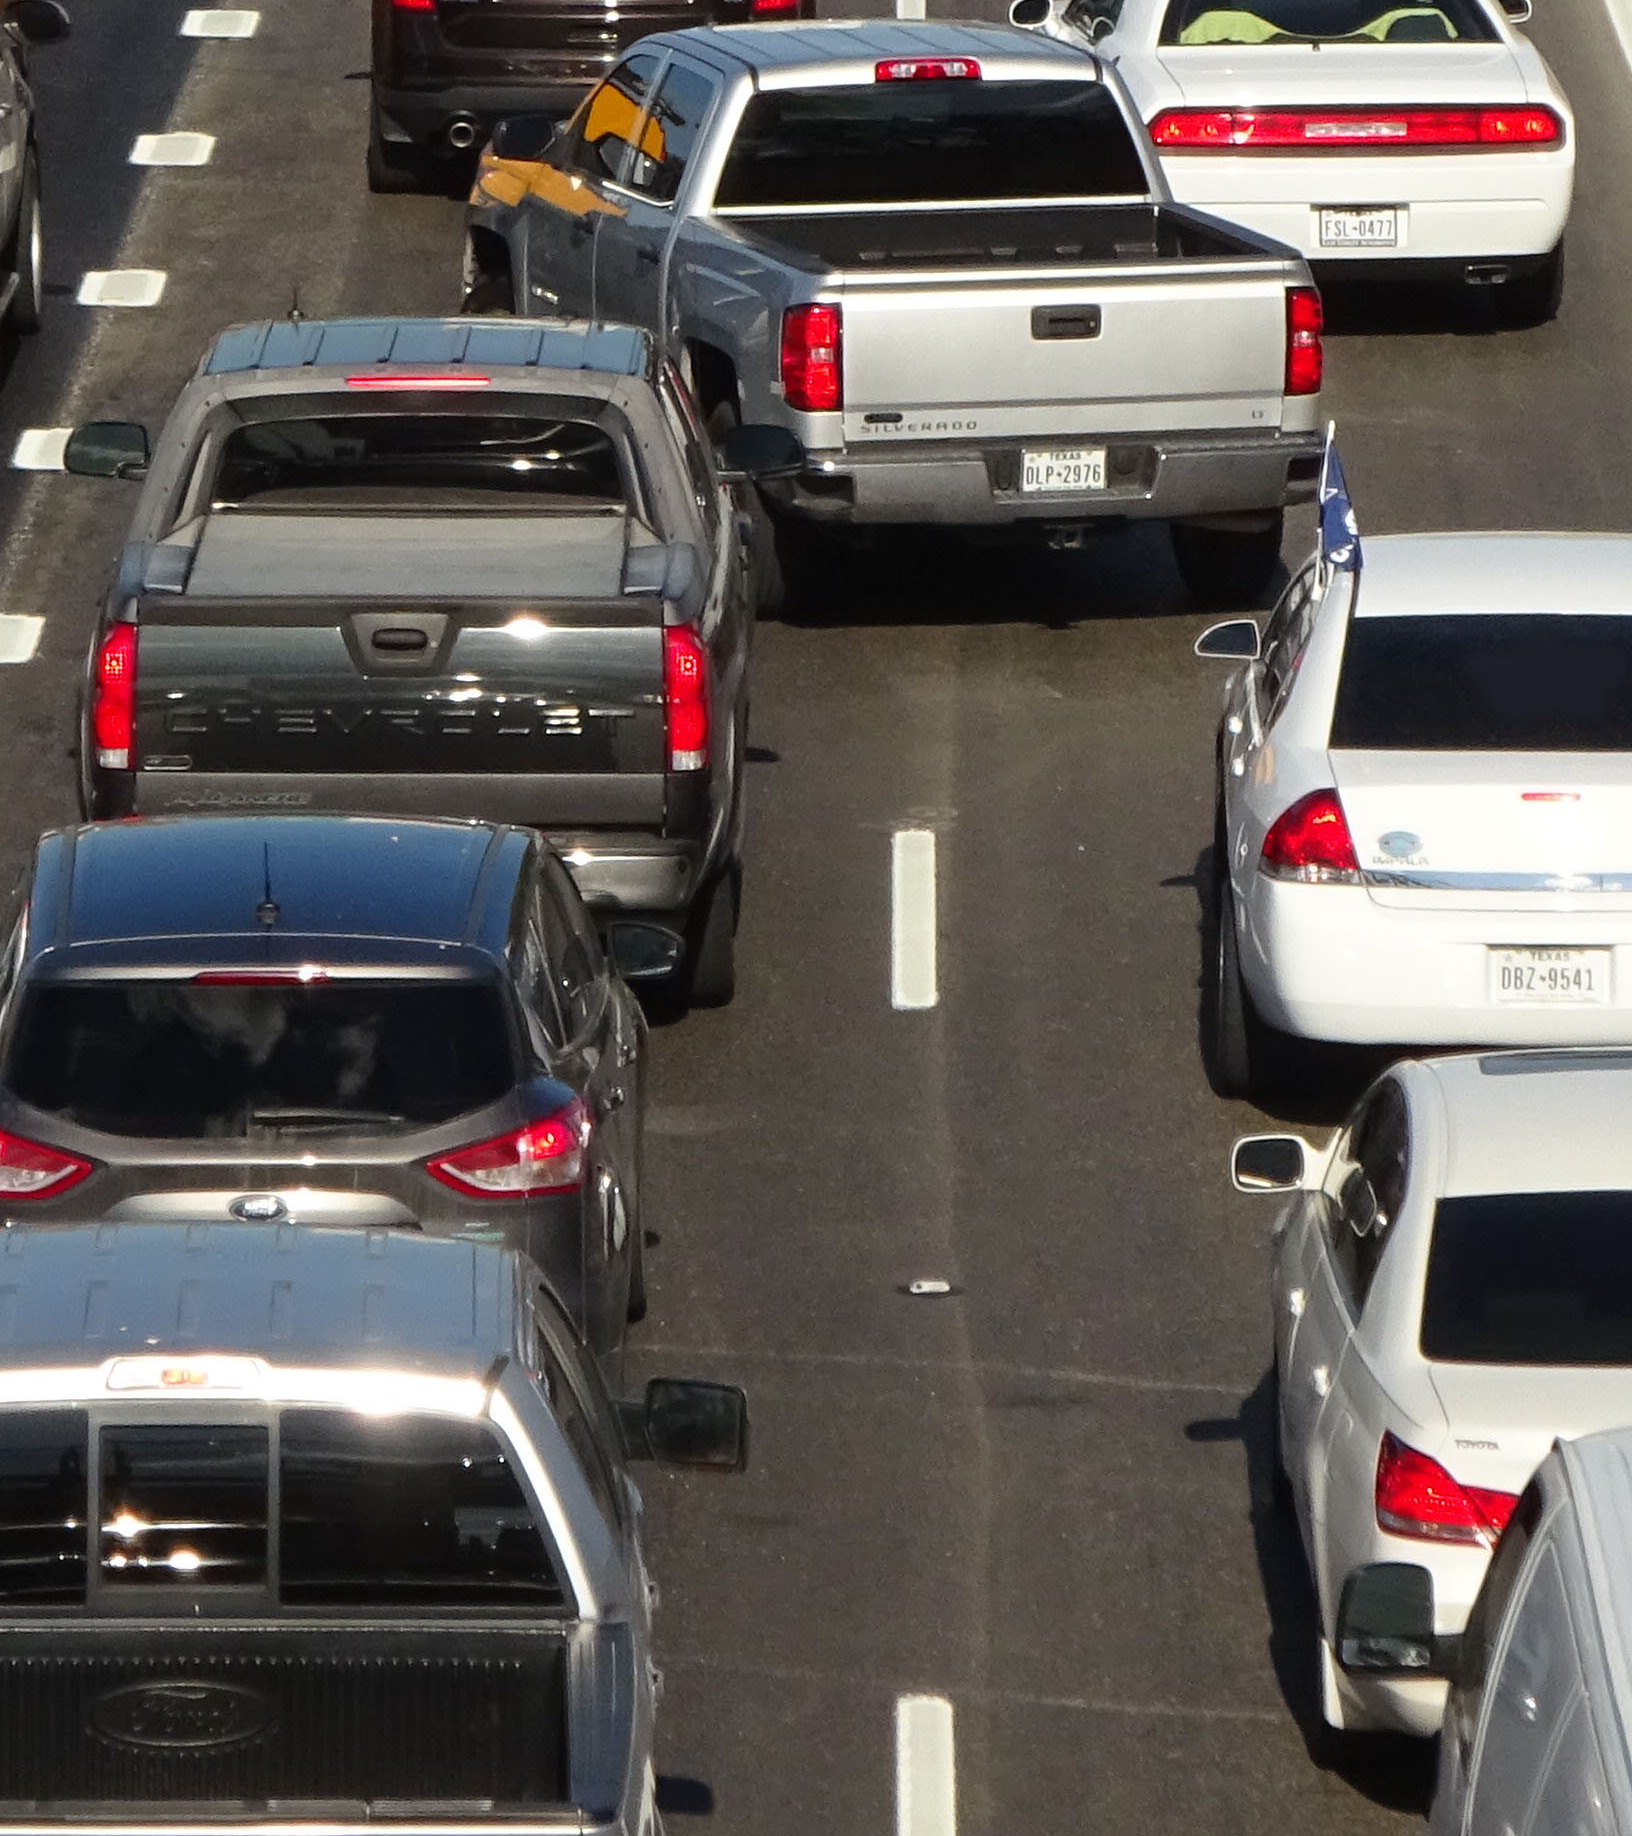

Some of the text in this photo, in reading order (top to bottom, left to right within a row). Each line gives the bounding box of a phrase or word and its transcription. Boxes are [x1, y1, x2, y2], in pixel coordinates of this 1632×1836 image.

[861, 421, 977, 434] SILVERADO
[1048, 452, 1081, 462] TEXAS
[164, 707, 634, 737] CHEVROLET
[1530, 951, 1570, 962] TEXAS
